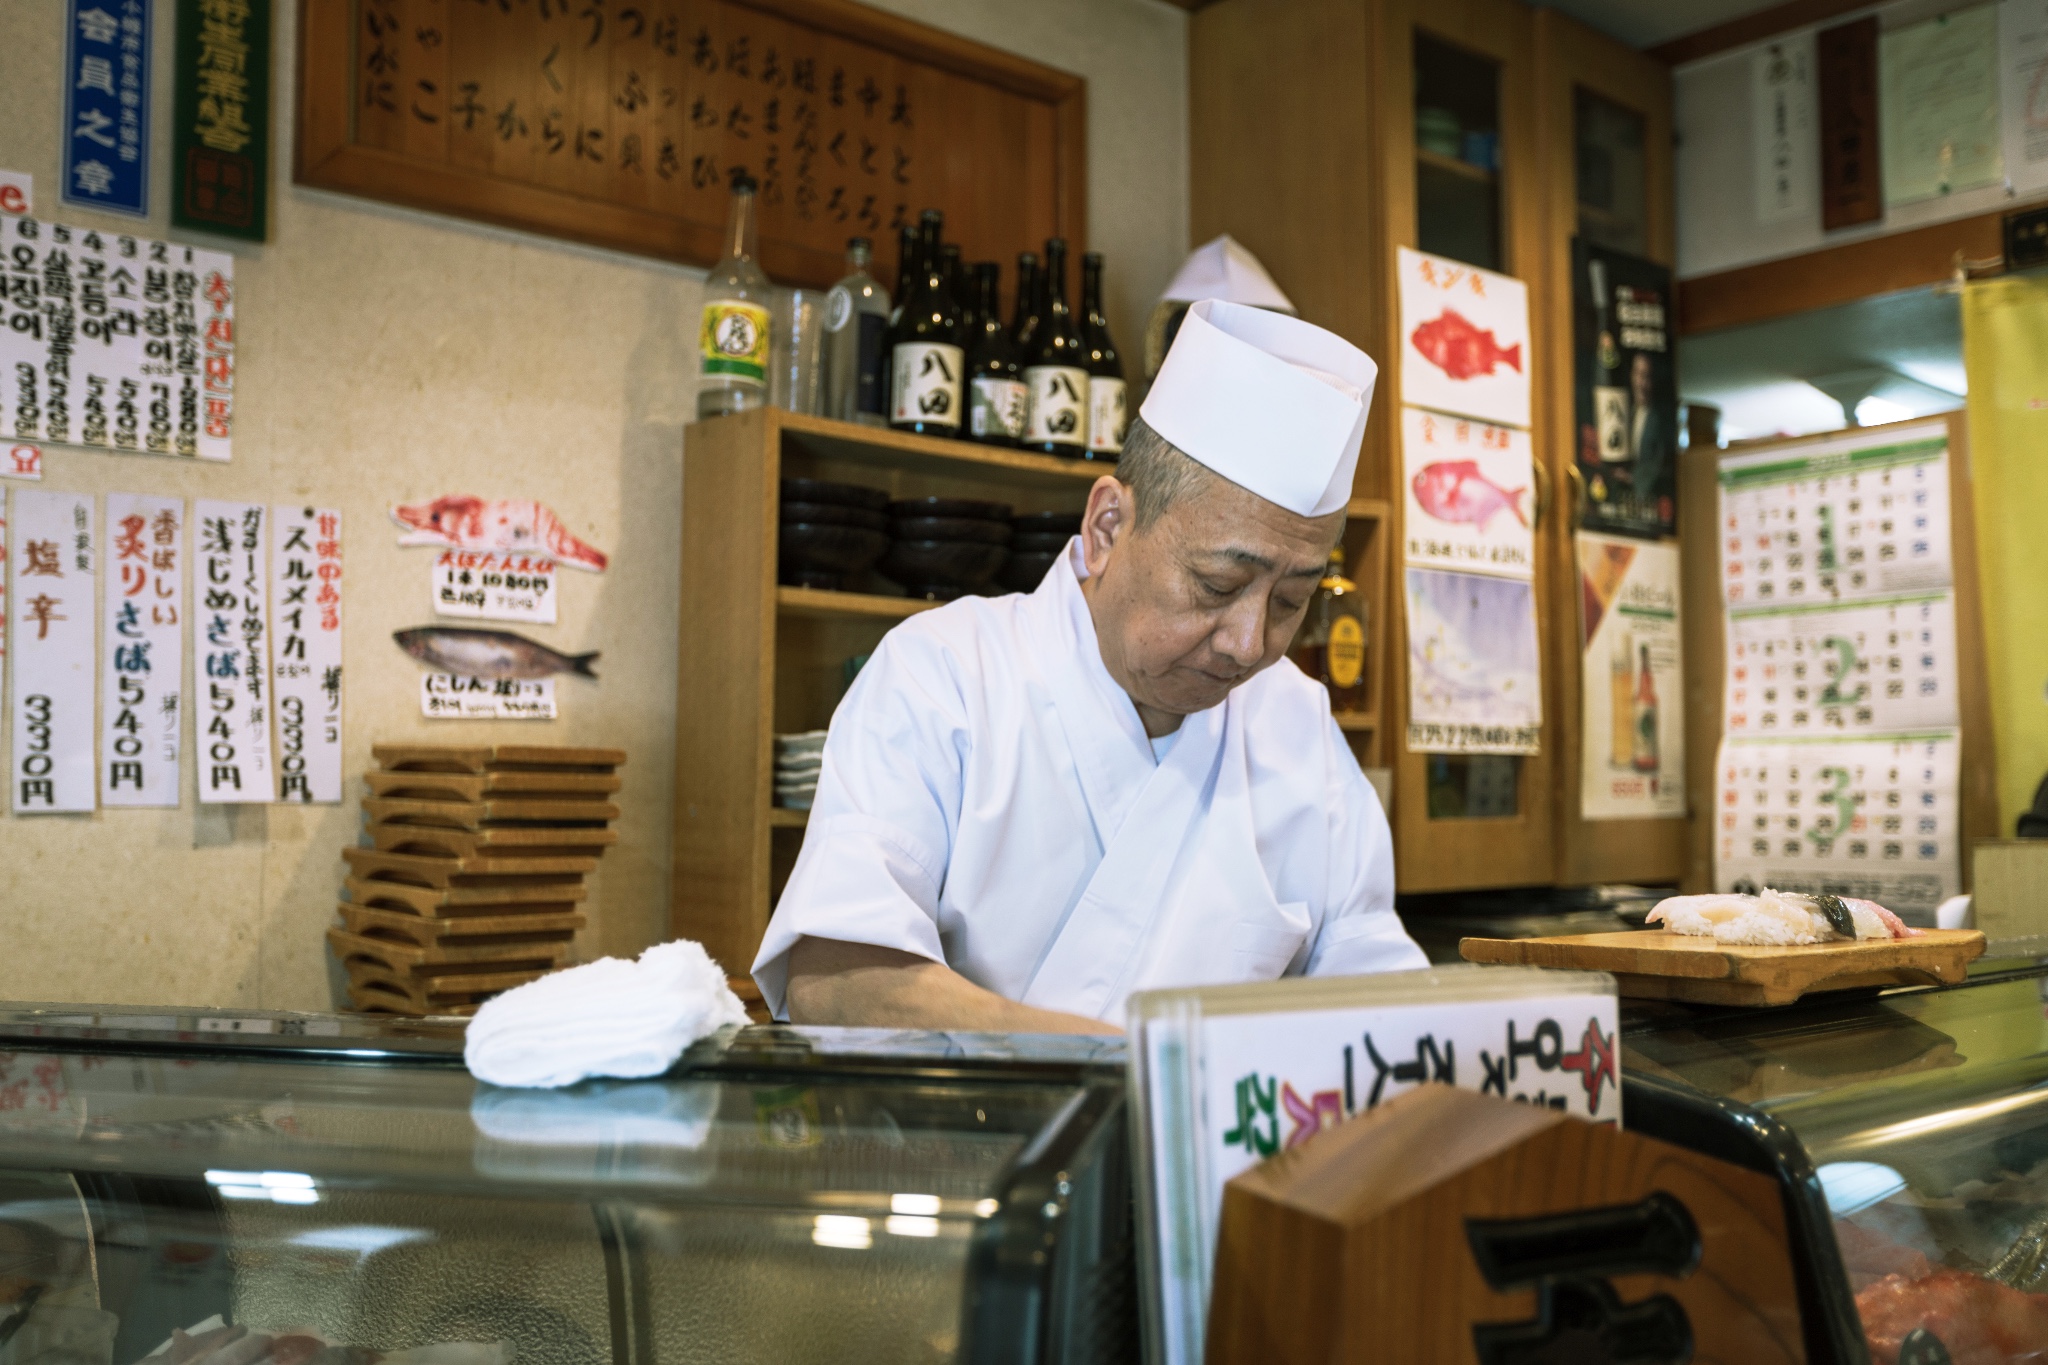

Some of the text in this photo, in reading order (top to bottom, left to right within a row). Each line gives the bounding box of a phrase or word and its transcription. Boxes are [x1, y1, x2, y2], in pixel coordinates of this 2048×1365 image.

[151, 508, 179, 626] 香ばしい
[281, 525, 313, 660] スルメイカ
[21, 538, 68, 806] 塩辛 330円
[281, 695, 307, 801] 330円
